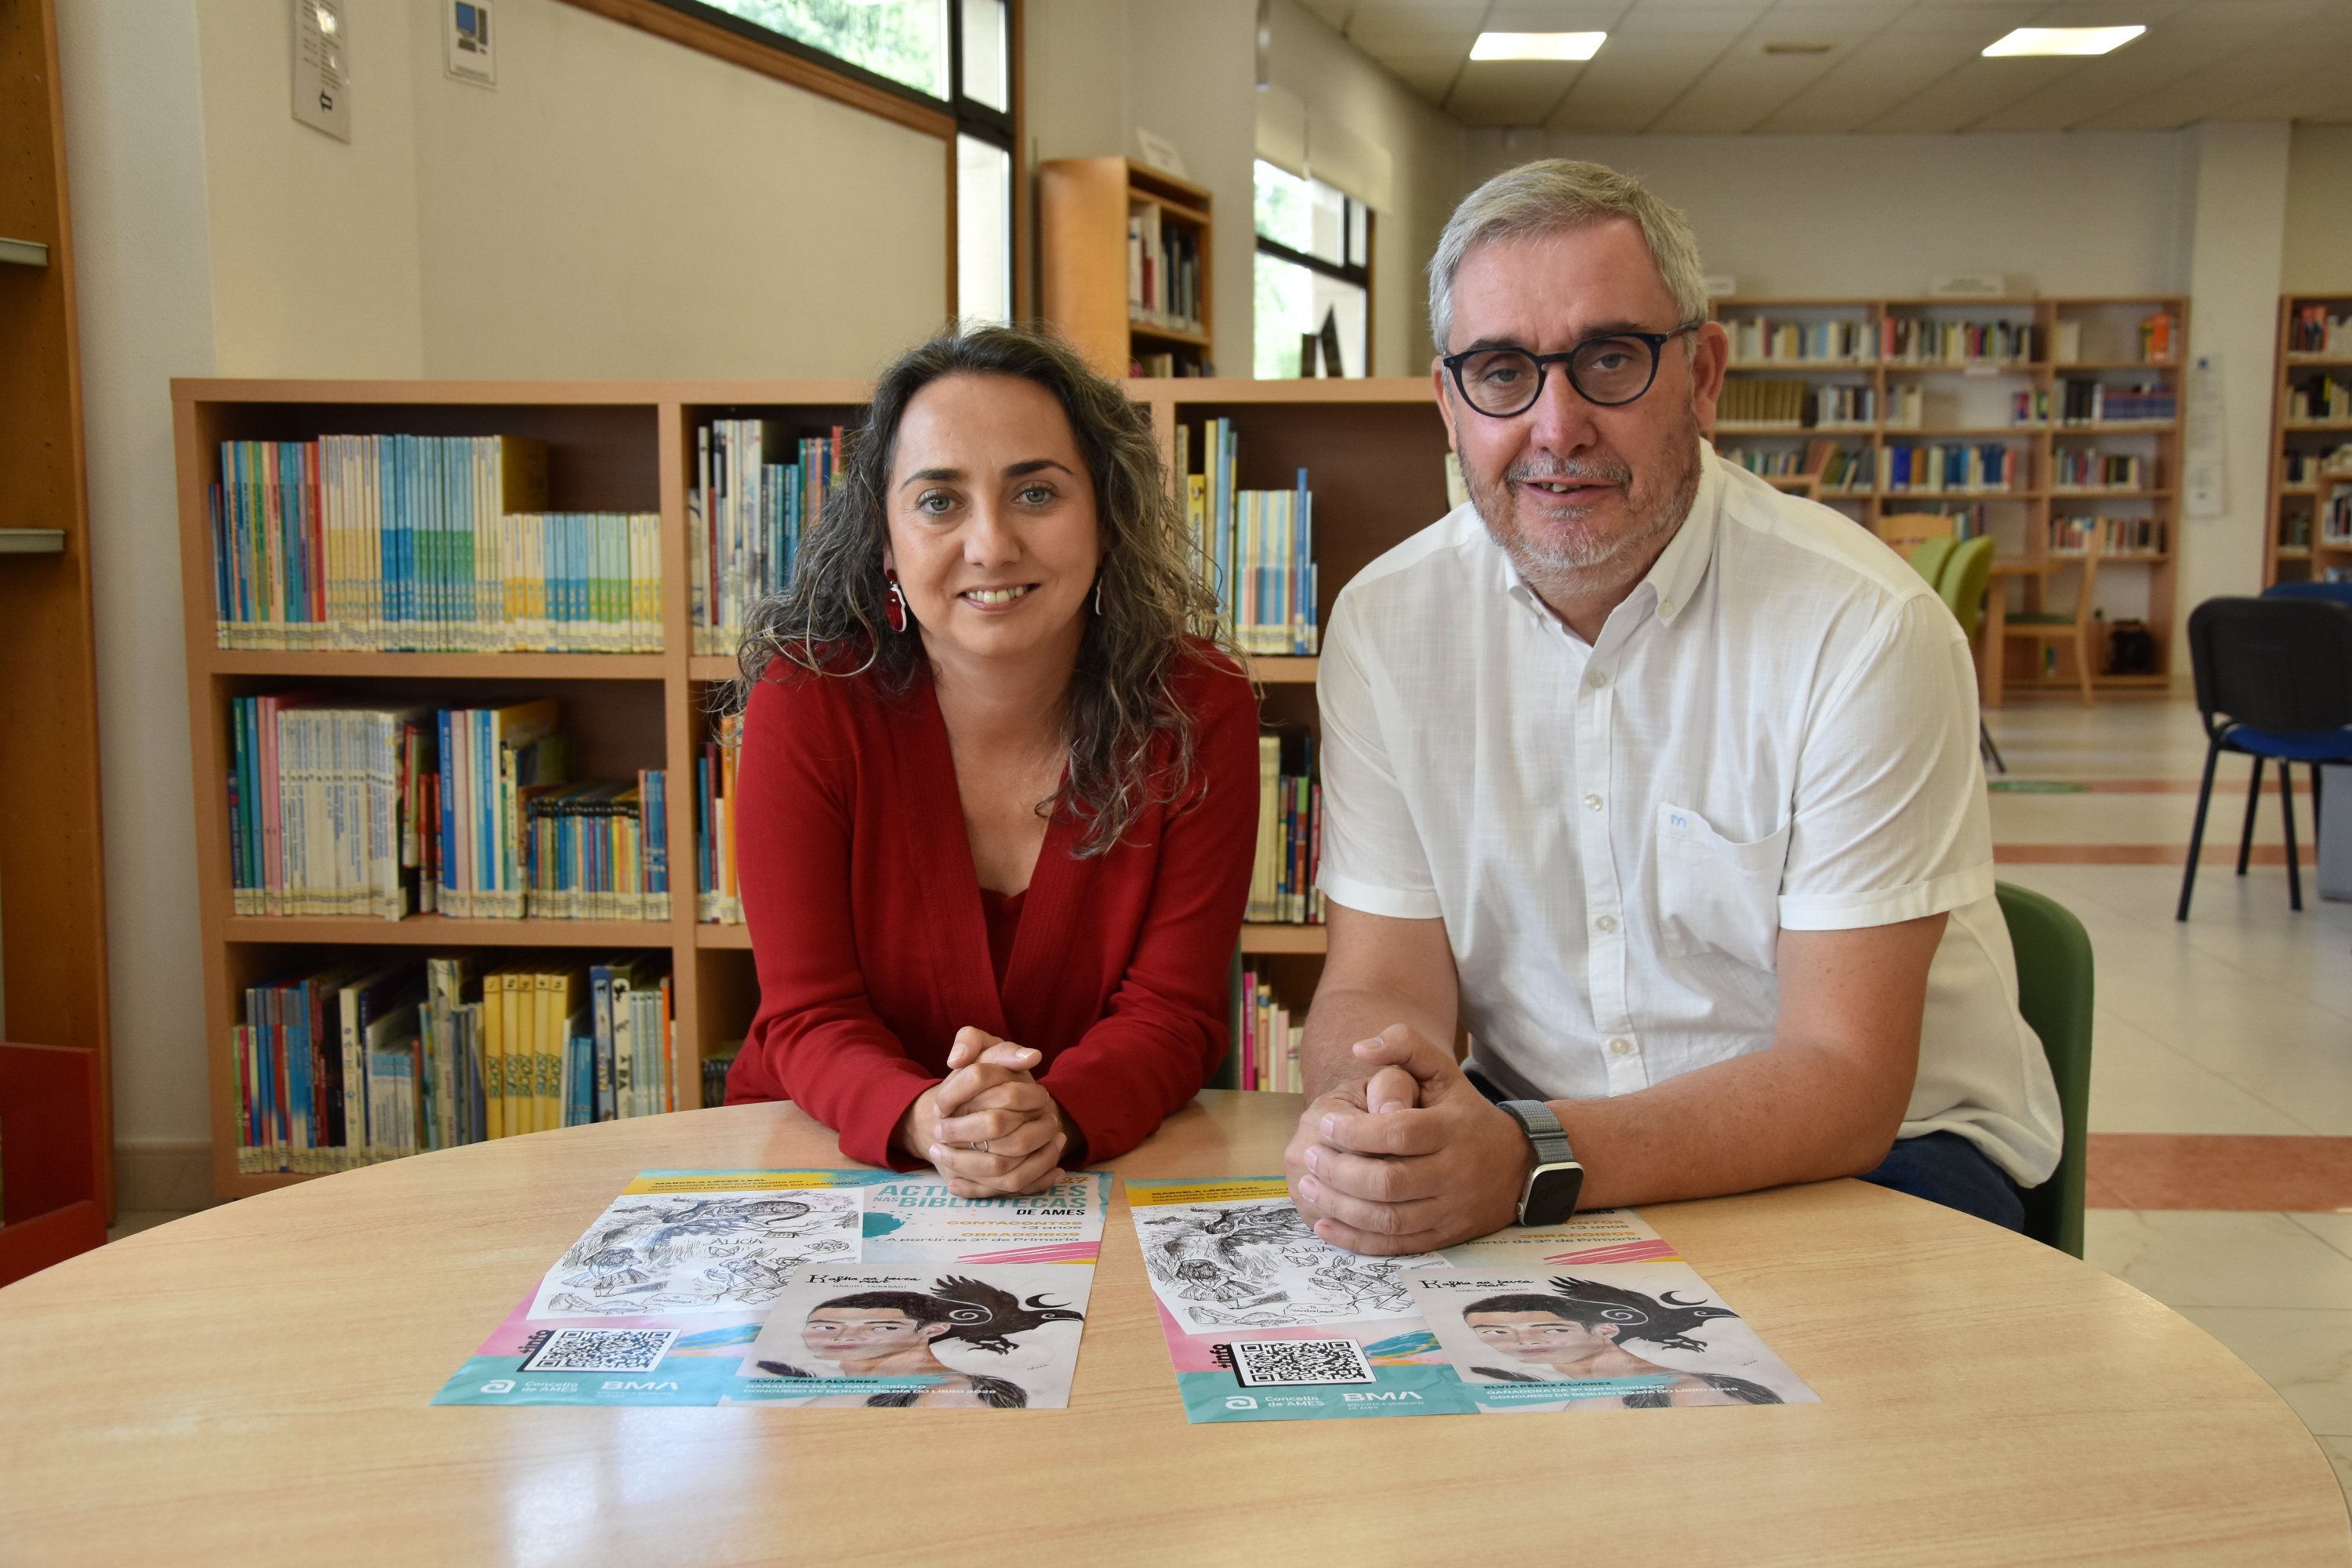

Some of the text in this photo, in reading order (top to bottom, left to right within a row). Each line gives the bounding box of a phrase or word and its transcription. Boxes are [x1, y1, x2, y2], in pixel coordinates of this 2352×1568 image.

[898, 1197, 1087, 1208] BIBLIOTECAS
[517, 1330, 550, 1354] +info
[1209, 1344, 1232, 1368] +info
